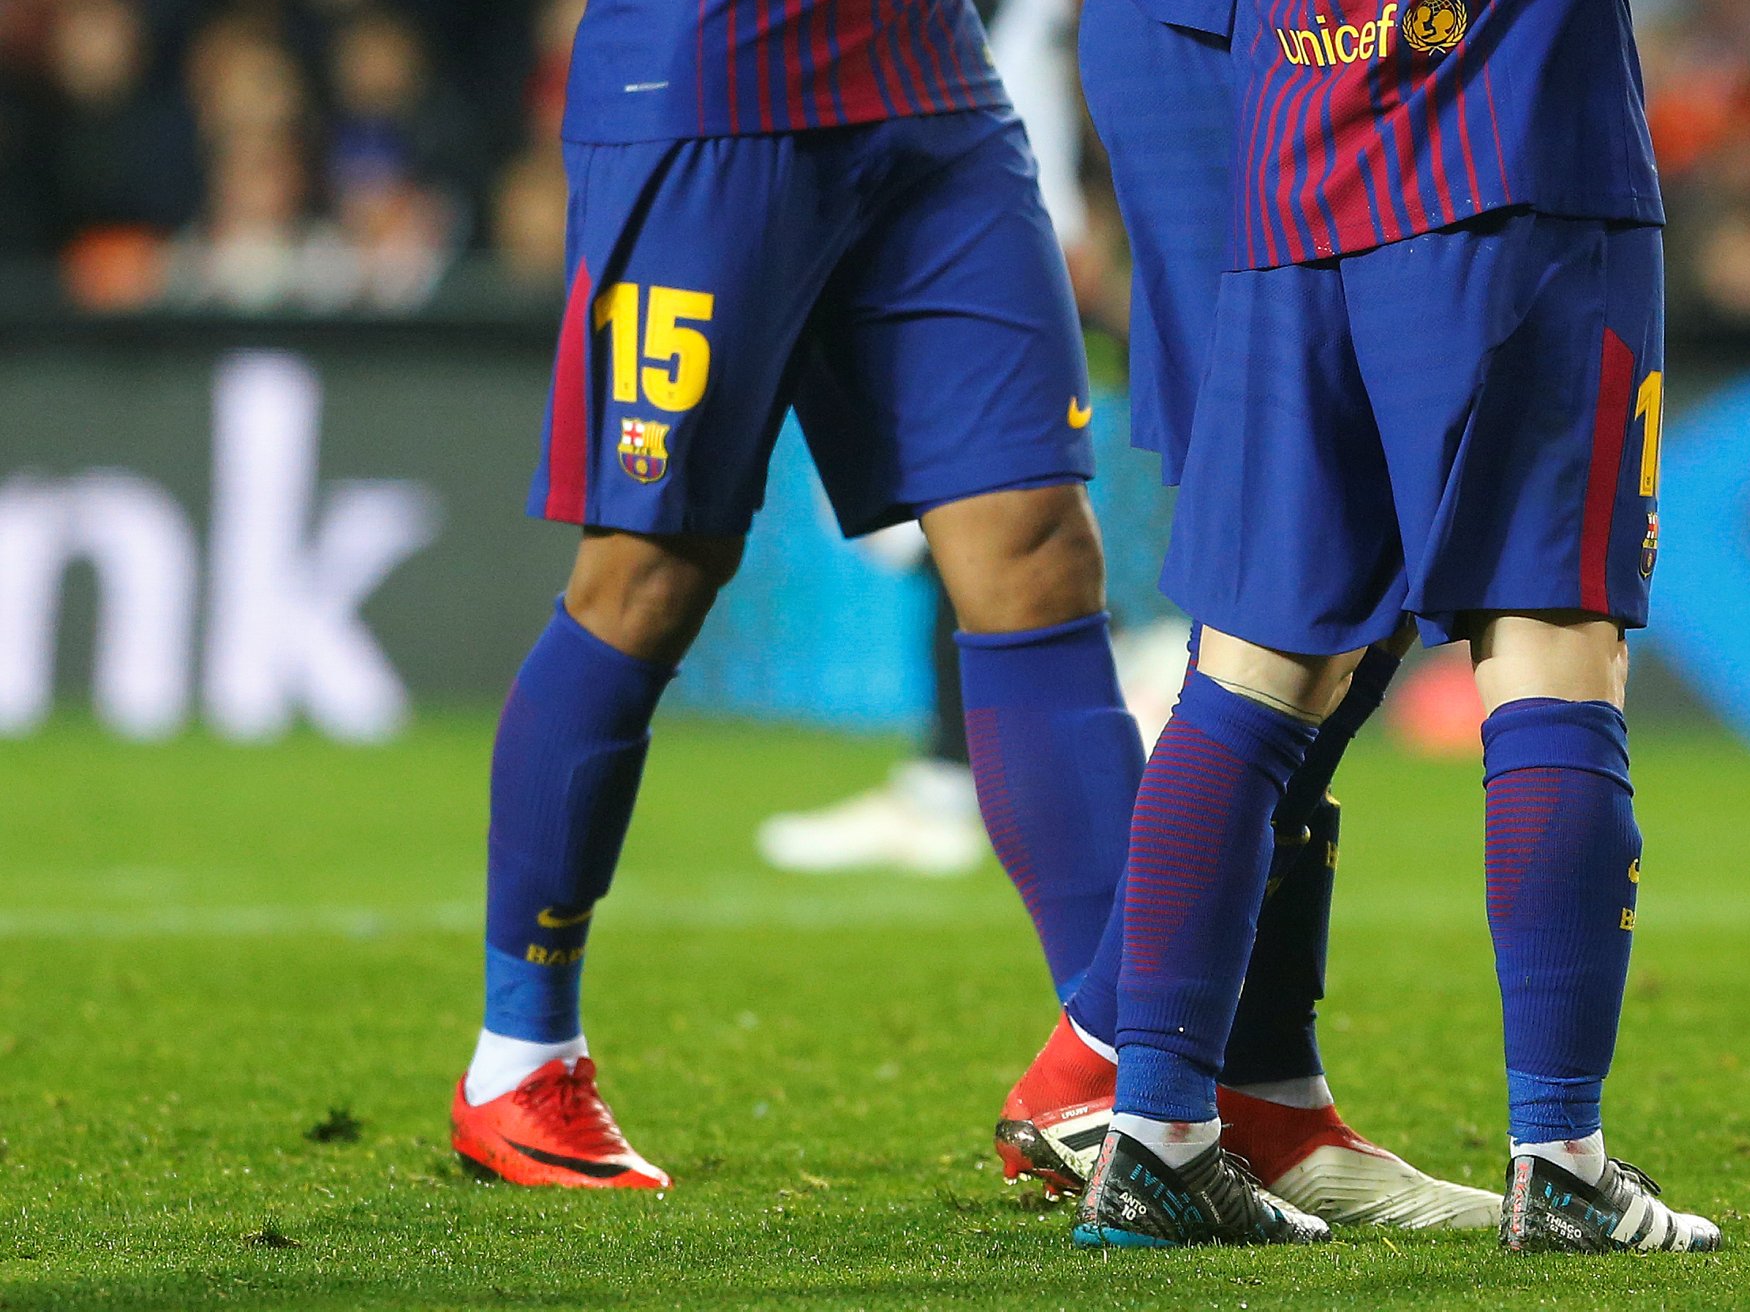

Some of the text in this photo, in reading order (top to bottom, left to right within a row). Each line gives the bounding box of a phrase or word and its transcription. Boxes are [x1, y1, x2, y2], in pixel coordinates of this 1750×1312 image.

[1276, 3, 1398, 67] unicef
[594, 282, 715, 413] 15
[1634, 370, 1662, 496] 1
[1620, 907, 1636, 931] B
[1119, 1191, 1147, 1215] ANTO
[1121, 1205, 1137, 1221] 10
[1545, 1212, 1582, 1239] THIAGO
